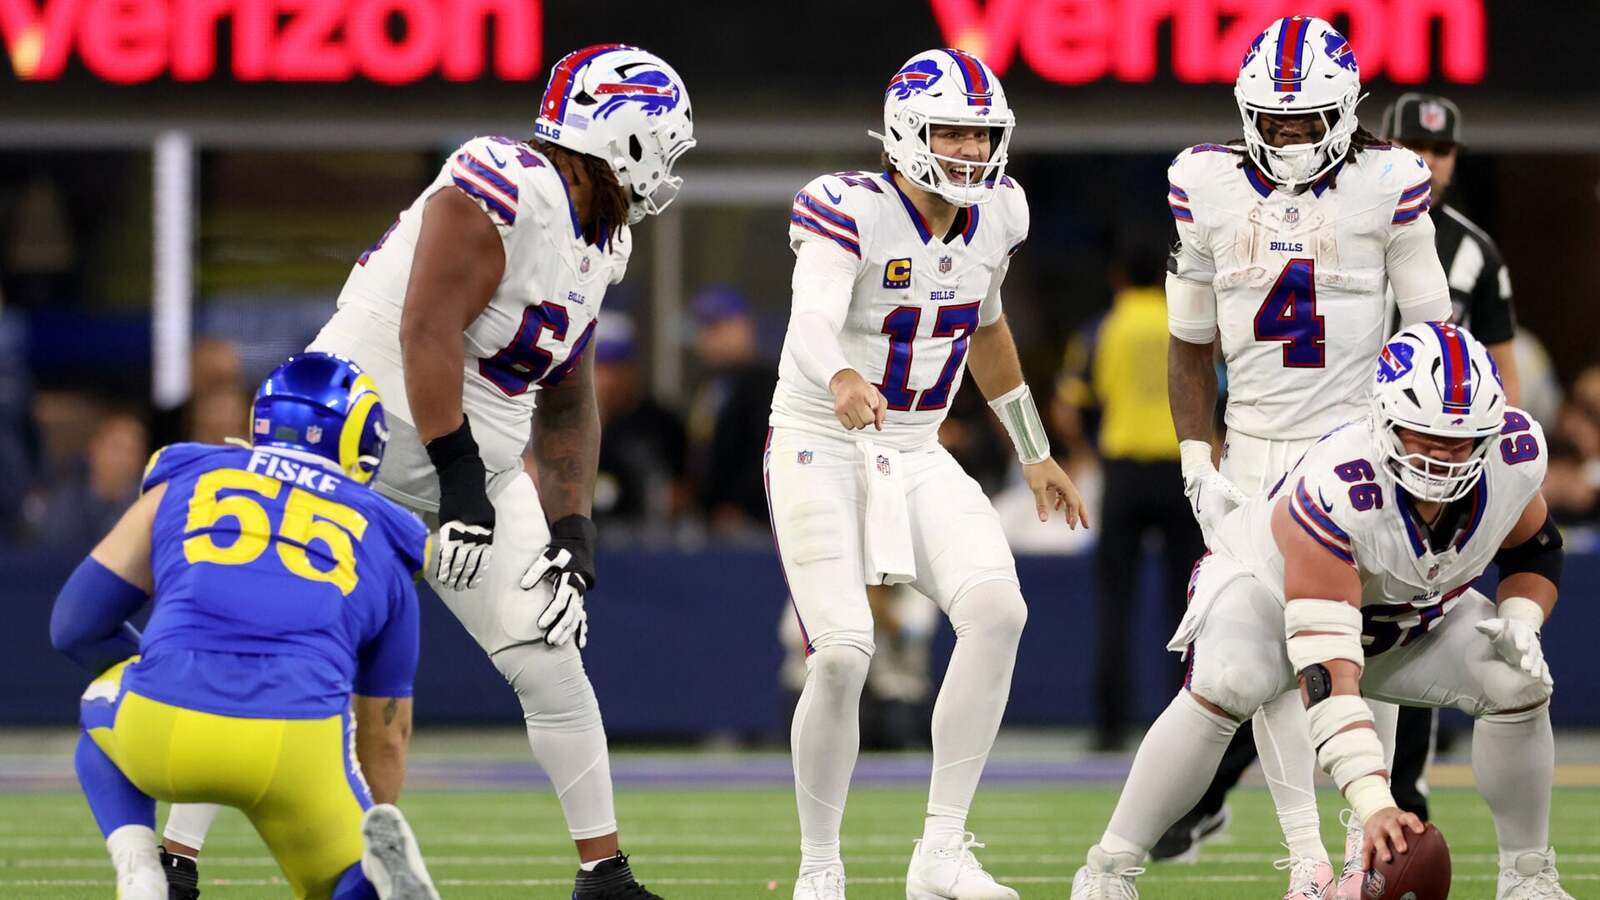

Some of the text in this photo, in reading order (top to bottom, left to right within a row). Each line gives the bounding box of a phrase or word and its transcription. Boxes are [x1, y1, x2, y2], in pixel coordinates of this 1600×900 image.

[0, 0, 543, 83] verizon
[886, 259, 911, 282] C
[1270, 241, 1303, 252] BILLS
[930, 290, 956, 301] BILLS
[1253, 258, 1326, 368] 4
[871, 301, 981, 411] 17
[246, 451, 343, 493] FISKE
[1333, 458, 1383, 512] 66
[182, 468, 370, 597] 55
